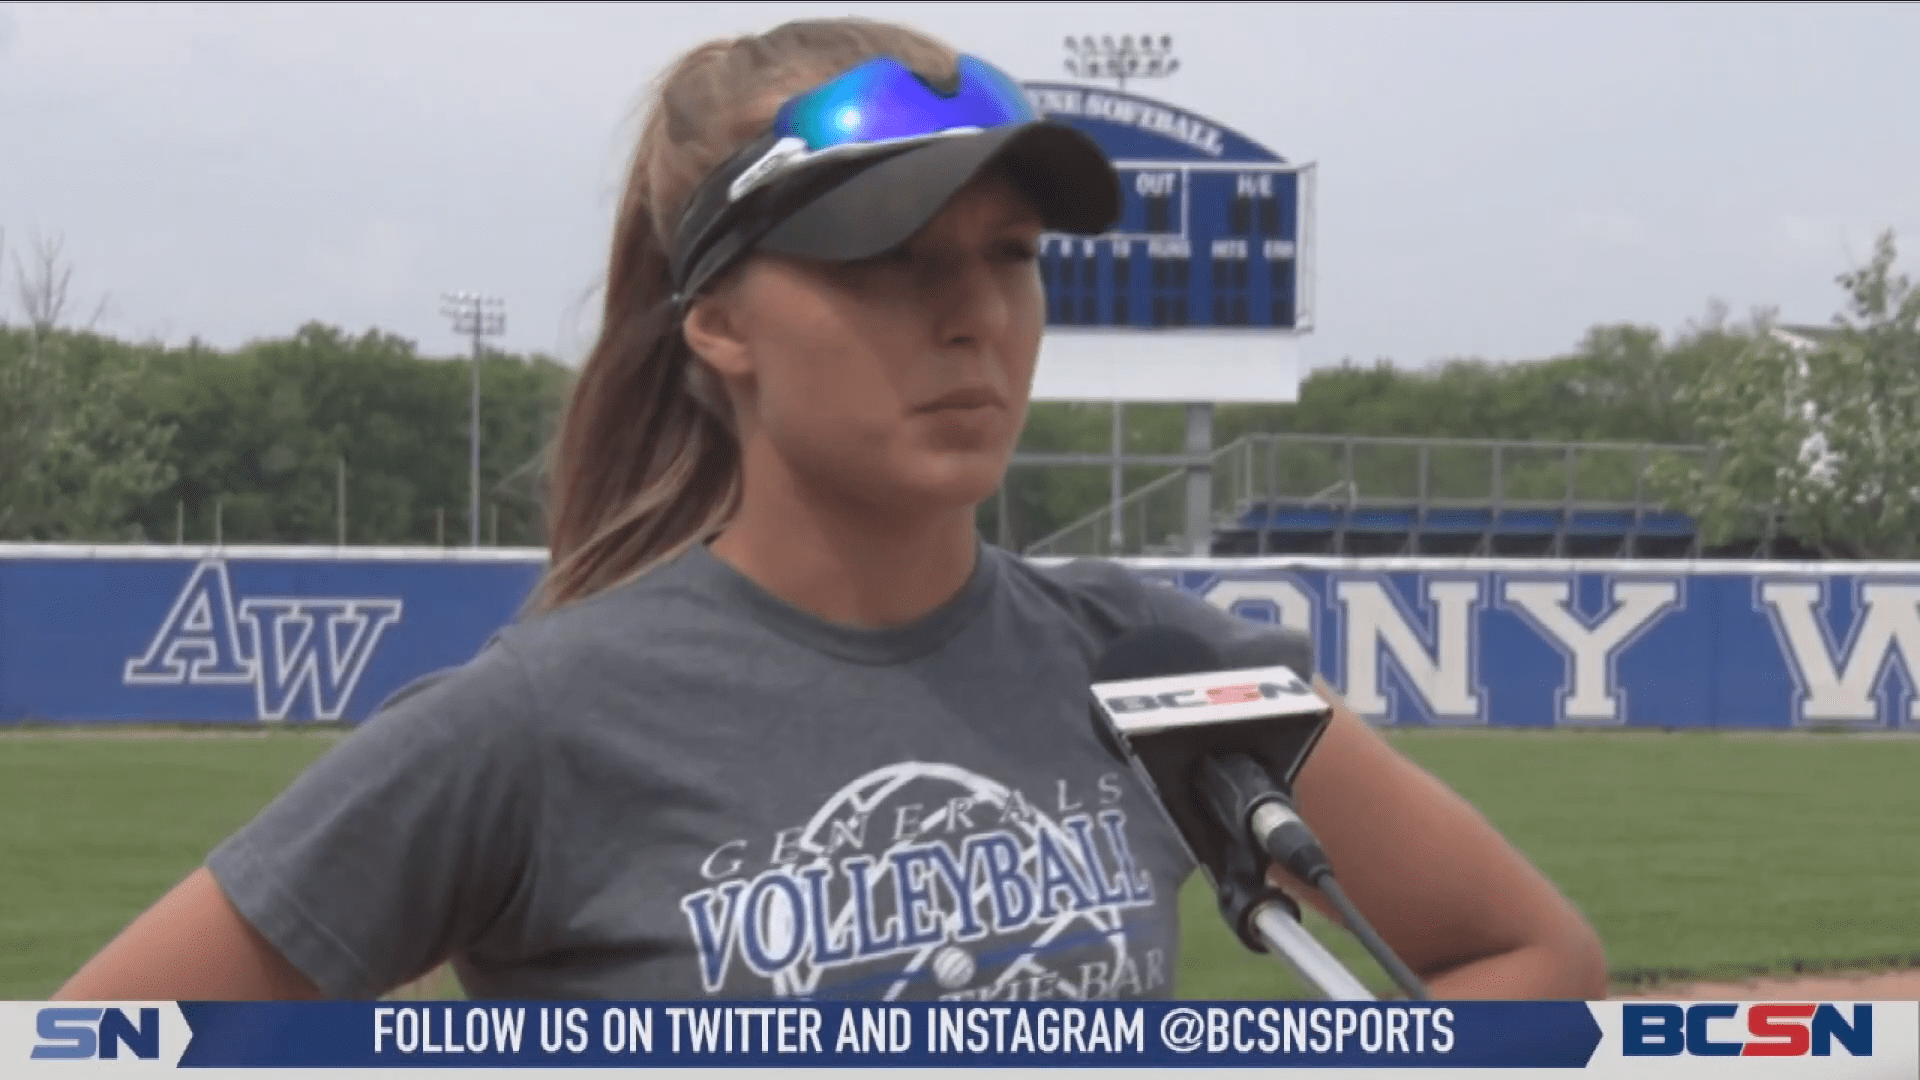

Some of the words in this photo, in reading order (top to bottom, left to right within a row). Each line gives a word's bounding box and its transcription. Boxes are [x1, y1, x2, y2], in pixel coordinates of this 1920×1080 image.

[1083, 92, 1225, 157] SOFTBALL
[1135, 172, 1177, 197] OUT
[1210, 239, 1249, 260] HITS
[122, 558, 403, 721] AW
[1104, 680, 1311, 714] BCSN
[701, 773, 1123, 880] GENERALS
[681, 810, 1155, 994] VOLLEYBALL
[1078, 947, 1166, 1001] BAR
